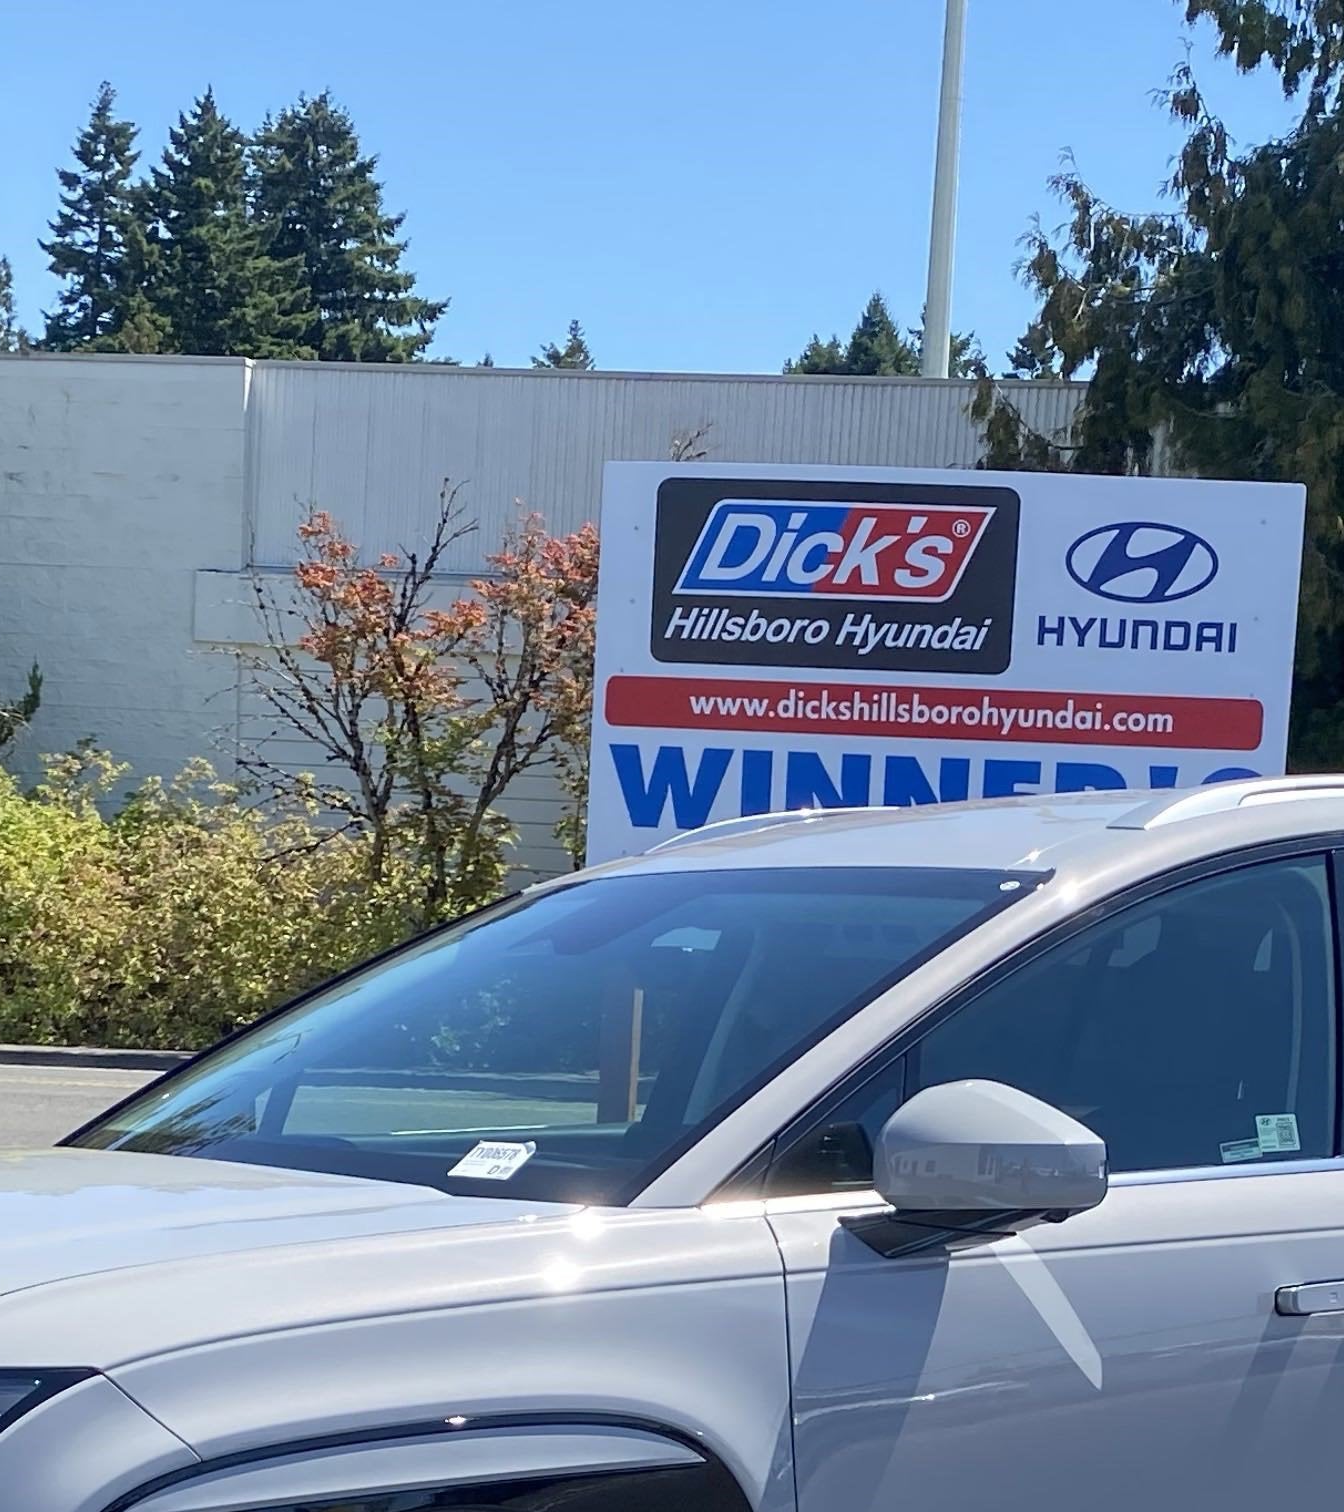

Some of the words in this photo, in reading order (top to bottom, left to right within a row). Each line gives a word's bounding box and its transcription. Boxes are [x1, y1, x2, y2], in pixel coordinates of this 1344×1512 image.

[700, 505, 955, 589] Dick's
[664, 607, 830, 646] Hillsboro
[836, 613, 992, 656] Hyundai
[1037, 616, 1237, 653] HYUNDAI
[689, 690, 1174, 734] www.dickshillsborohyundai.com
